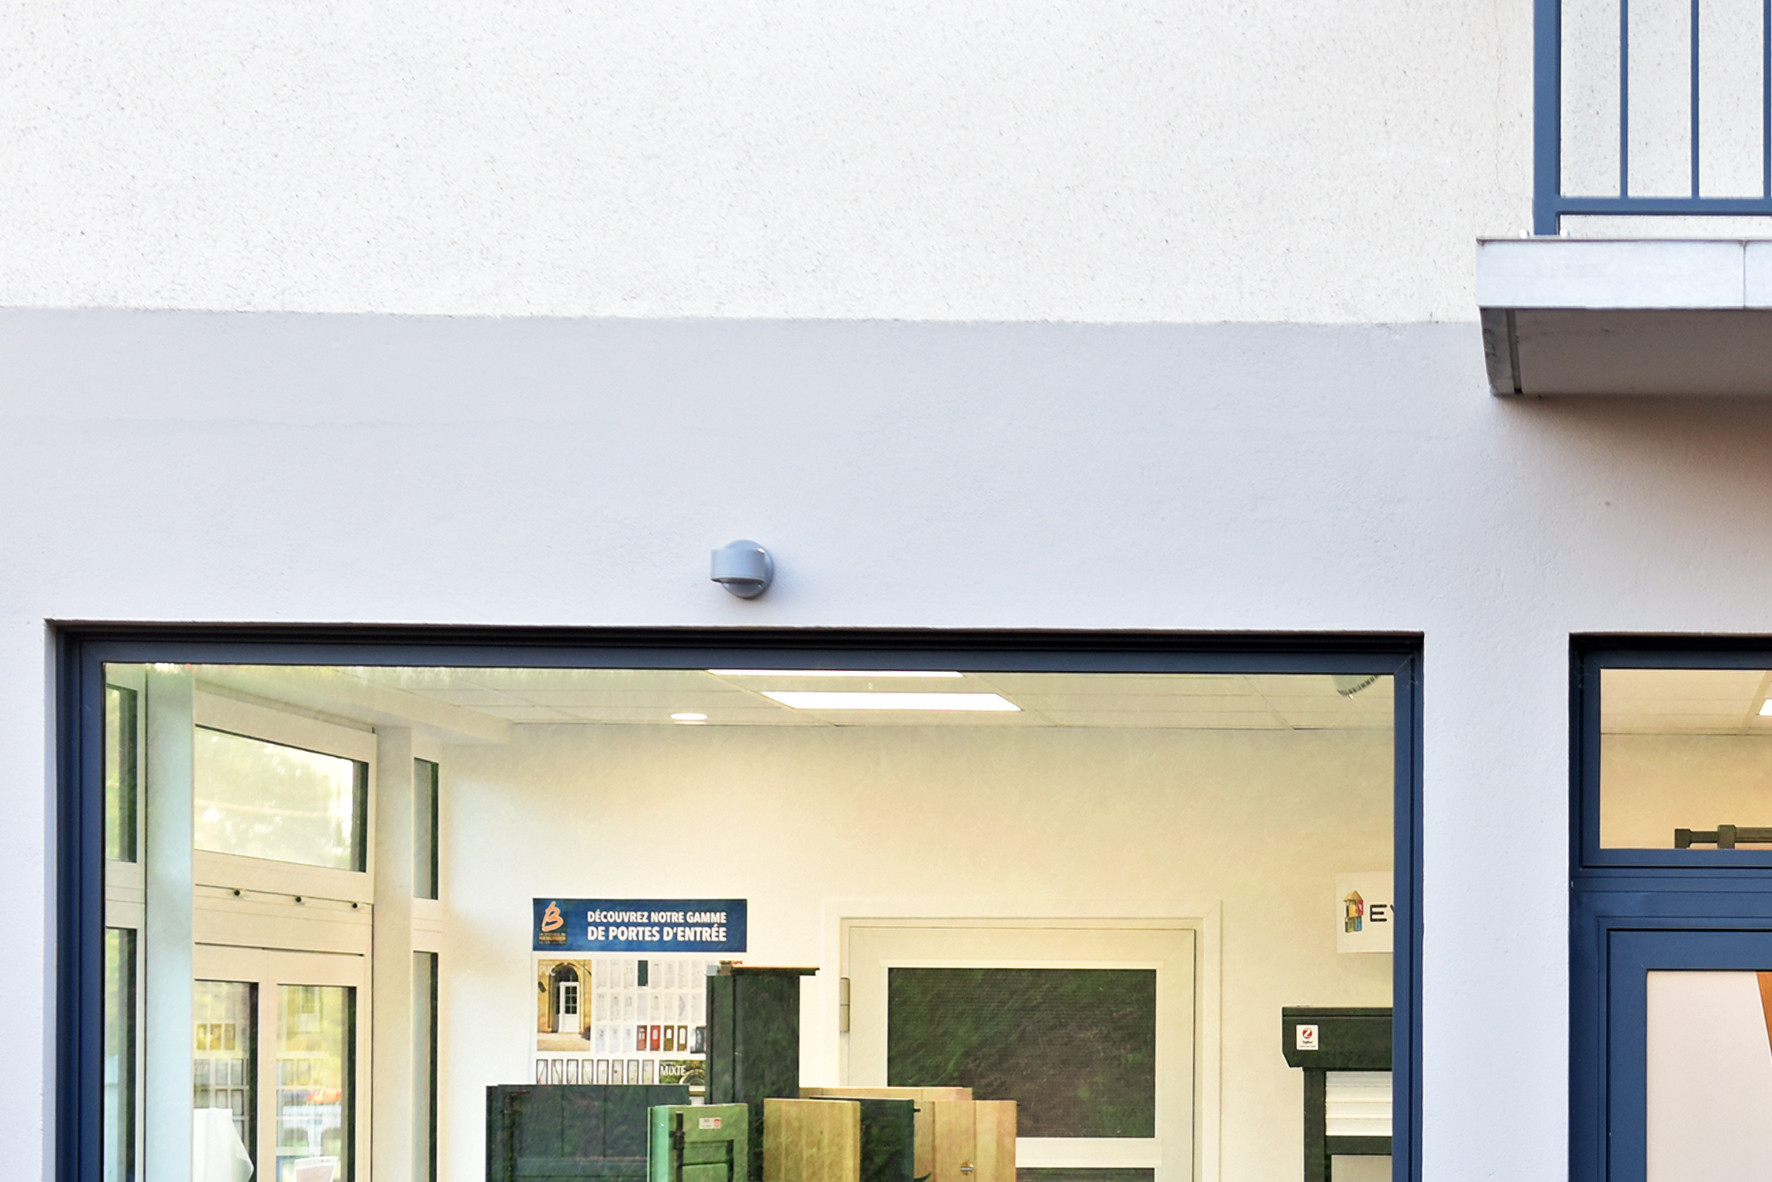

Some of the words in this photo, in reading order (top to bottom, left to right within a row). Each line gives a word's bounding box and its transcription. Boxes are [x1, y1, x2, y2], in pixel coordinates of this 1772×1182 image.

[587, 909, 649, 923] DÉCOUVREZ
[650, 911, 685, 923] NOTRE
[686, 911, 727, 924] GAMME
[587, 926, 606, 941] DE
[608, 926, 660, 941] PORTES
[663, 923, 727, 941] D'ENTRÉE
